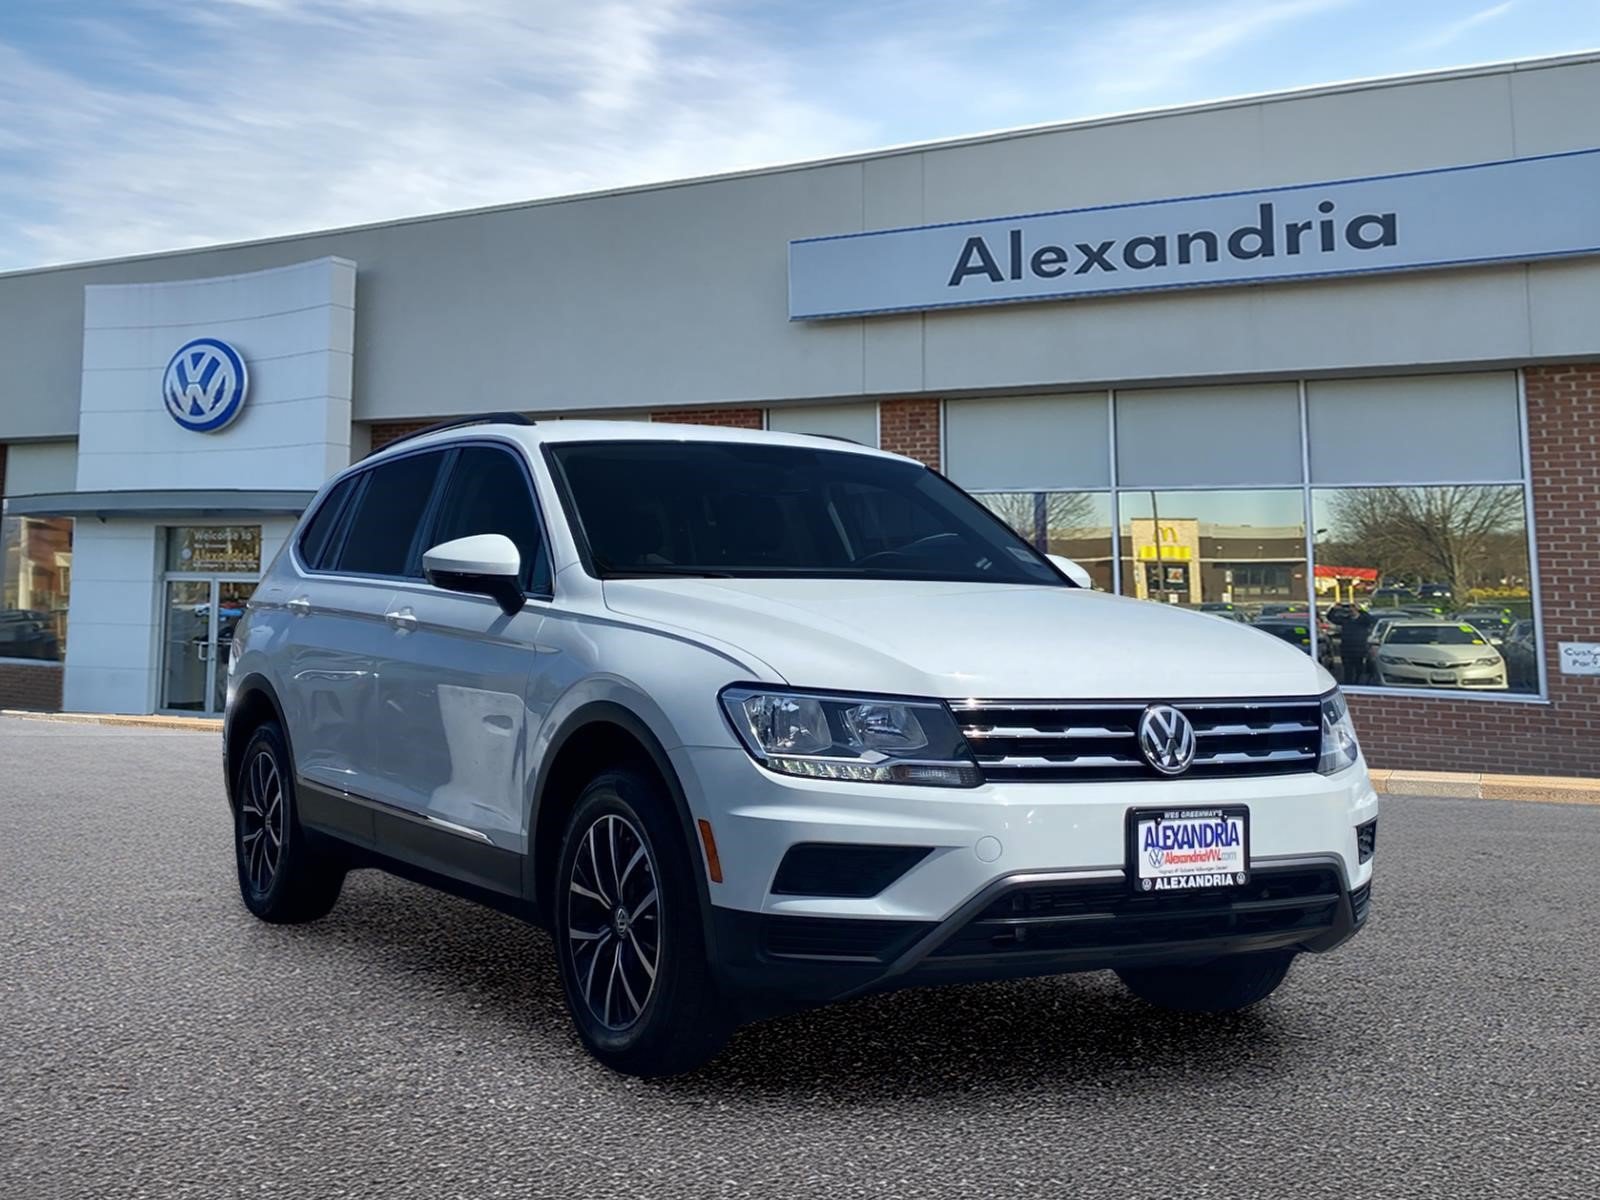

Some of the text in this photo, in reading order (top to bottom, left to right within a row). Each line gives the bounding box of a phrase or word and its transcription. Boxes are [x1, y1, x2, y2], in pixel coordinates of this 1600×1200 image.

[948, 200, 1397, 286] Alexandria
[1144, 822, 1240, 851] ALEXANDRIA
[1155, 873, 1234, 890] ALEXANDRIA
